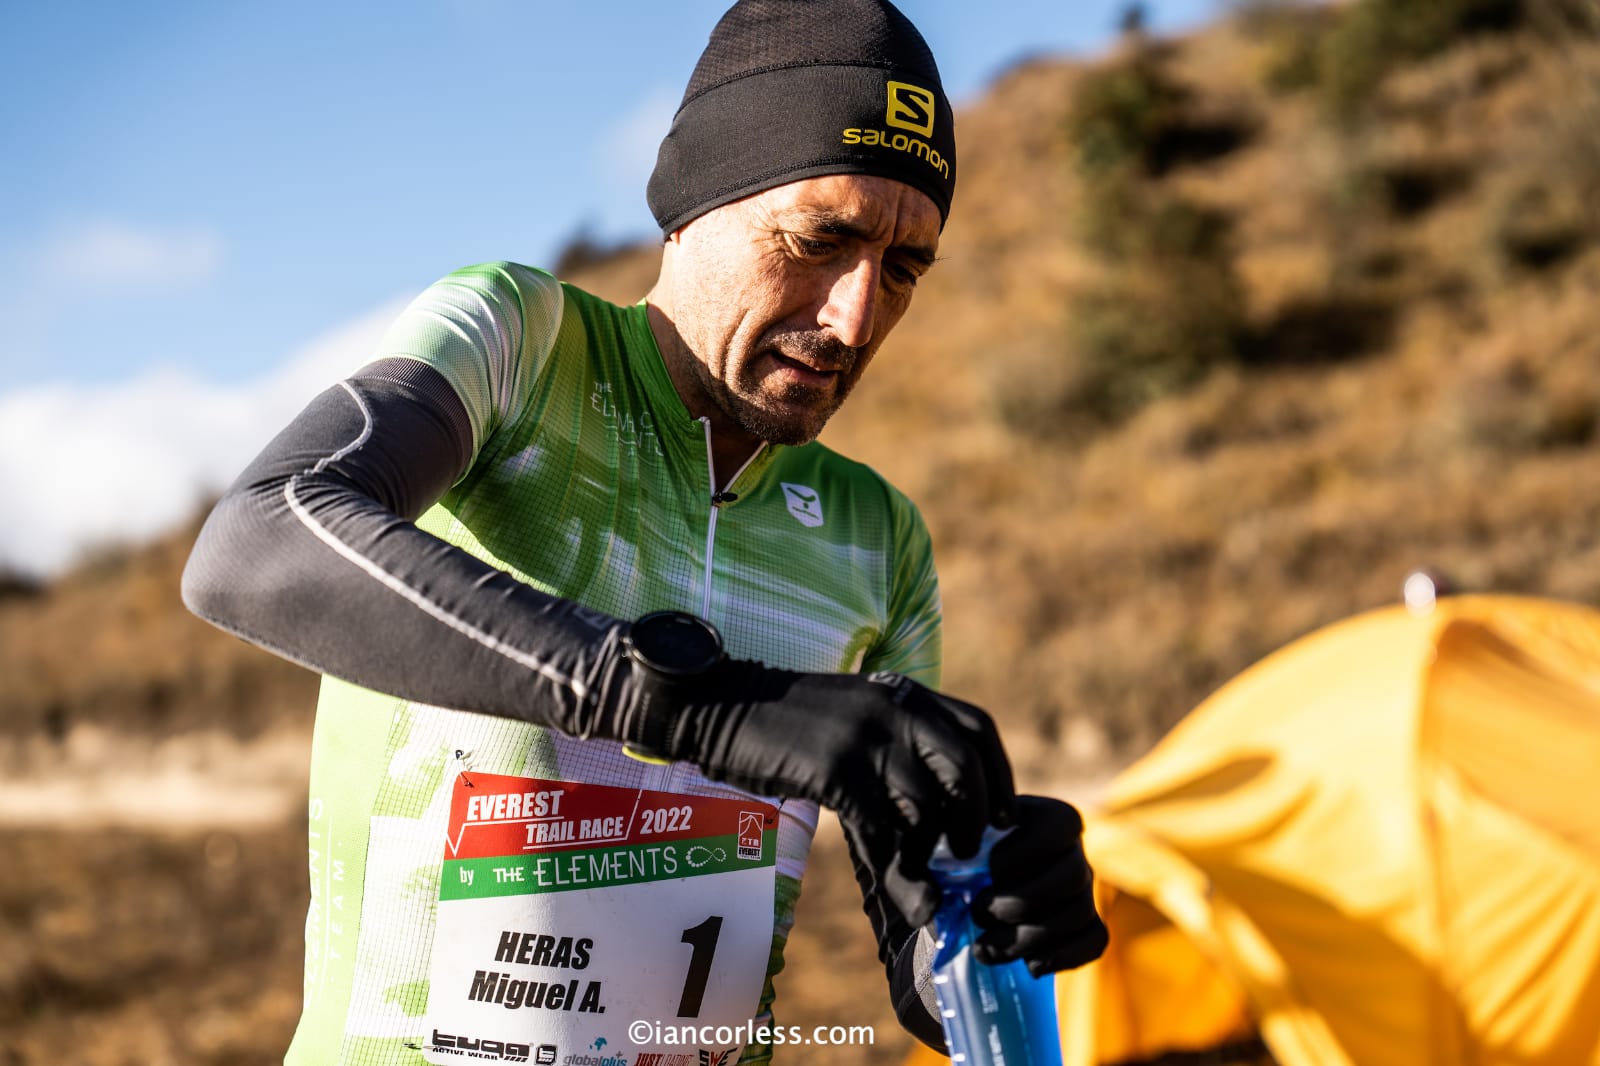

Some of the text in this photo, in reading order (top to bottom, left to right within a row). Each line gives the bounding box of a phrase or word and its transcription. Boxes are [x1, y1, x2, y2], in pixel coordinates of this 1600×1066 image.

[467, 790, 565, 821] EVEREST
[639, 805, 693, 836] 2022
[525, 816, 625, 845] TRAIL RACE
[459, 846, 678, 887] by THE ELEMENTS
[494, 930, 594, 970] HERAS
[676, 915, 723, 1018] 1
[468, 970, 606, 1014] Miguel A.
[432, 1047, 498, 1061] ACTIVE WEAR
